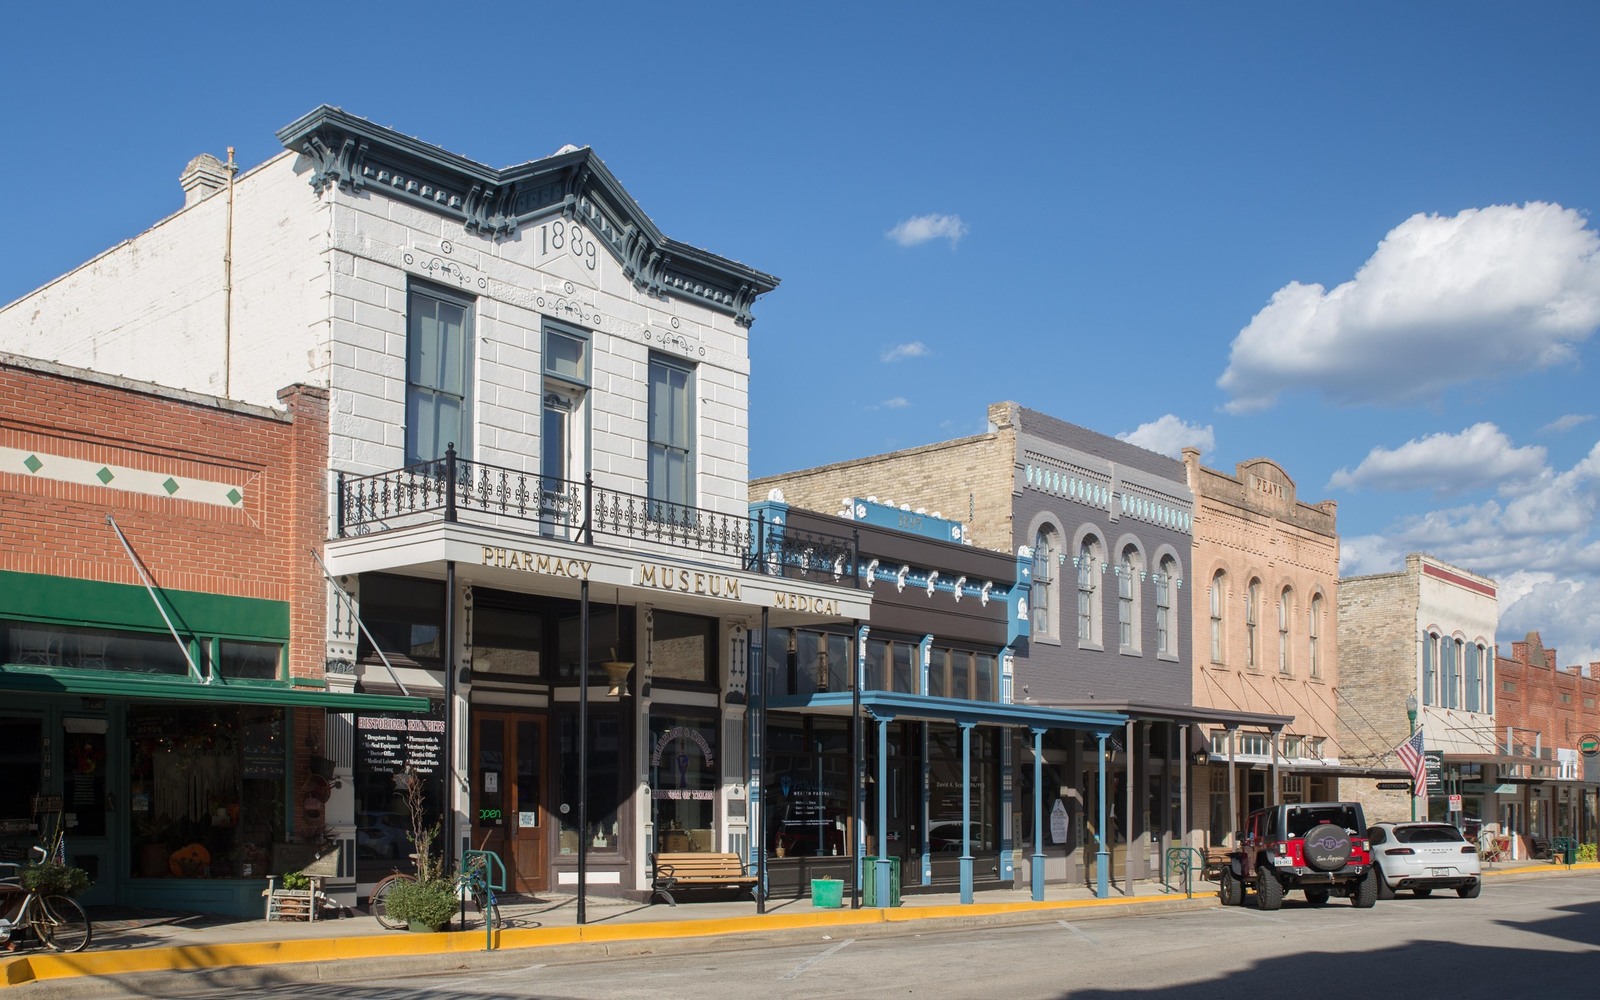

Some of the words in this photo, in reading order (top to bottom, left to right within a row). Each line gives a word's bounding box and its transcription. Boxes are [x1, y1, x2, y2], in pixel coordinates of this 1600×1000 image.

[542, 221, 596, 270] 1889
[481, 545, 592, 580] PHARMACY
[639, 563, 741, 600] MUSEUM
[774, 591, 842, 617] MEDICAL
[358, 717, 407, 730] HISTORICAL
[682, 790, 691, 800] OF
[478, 808, 502, 821] open
